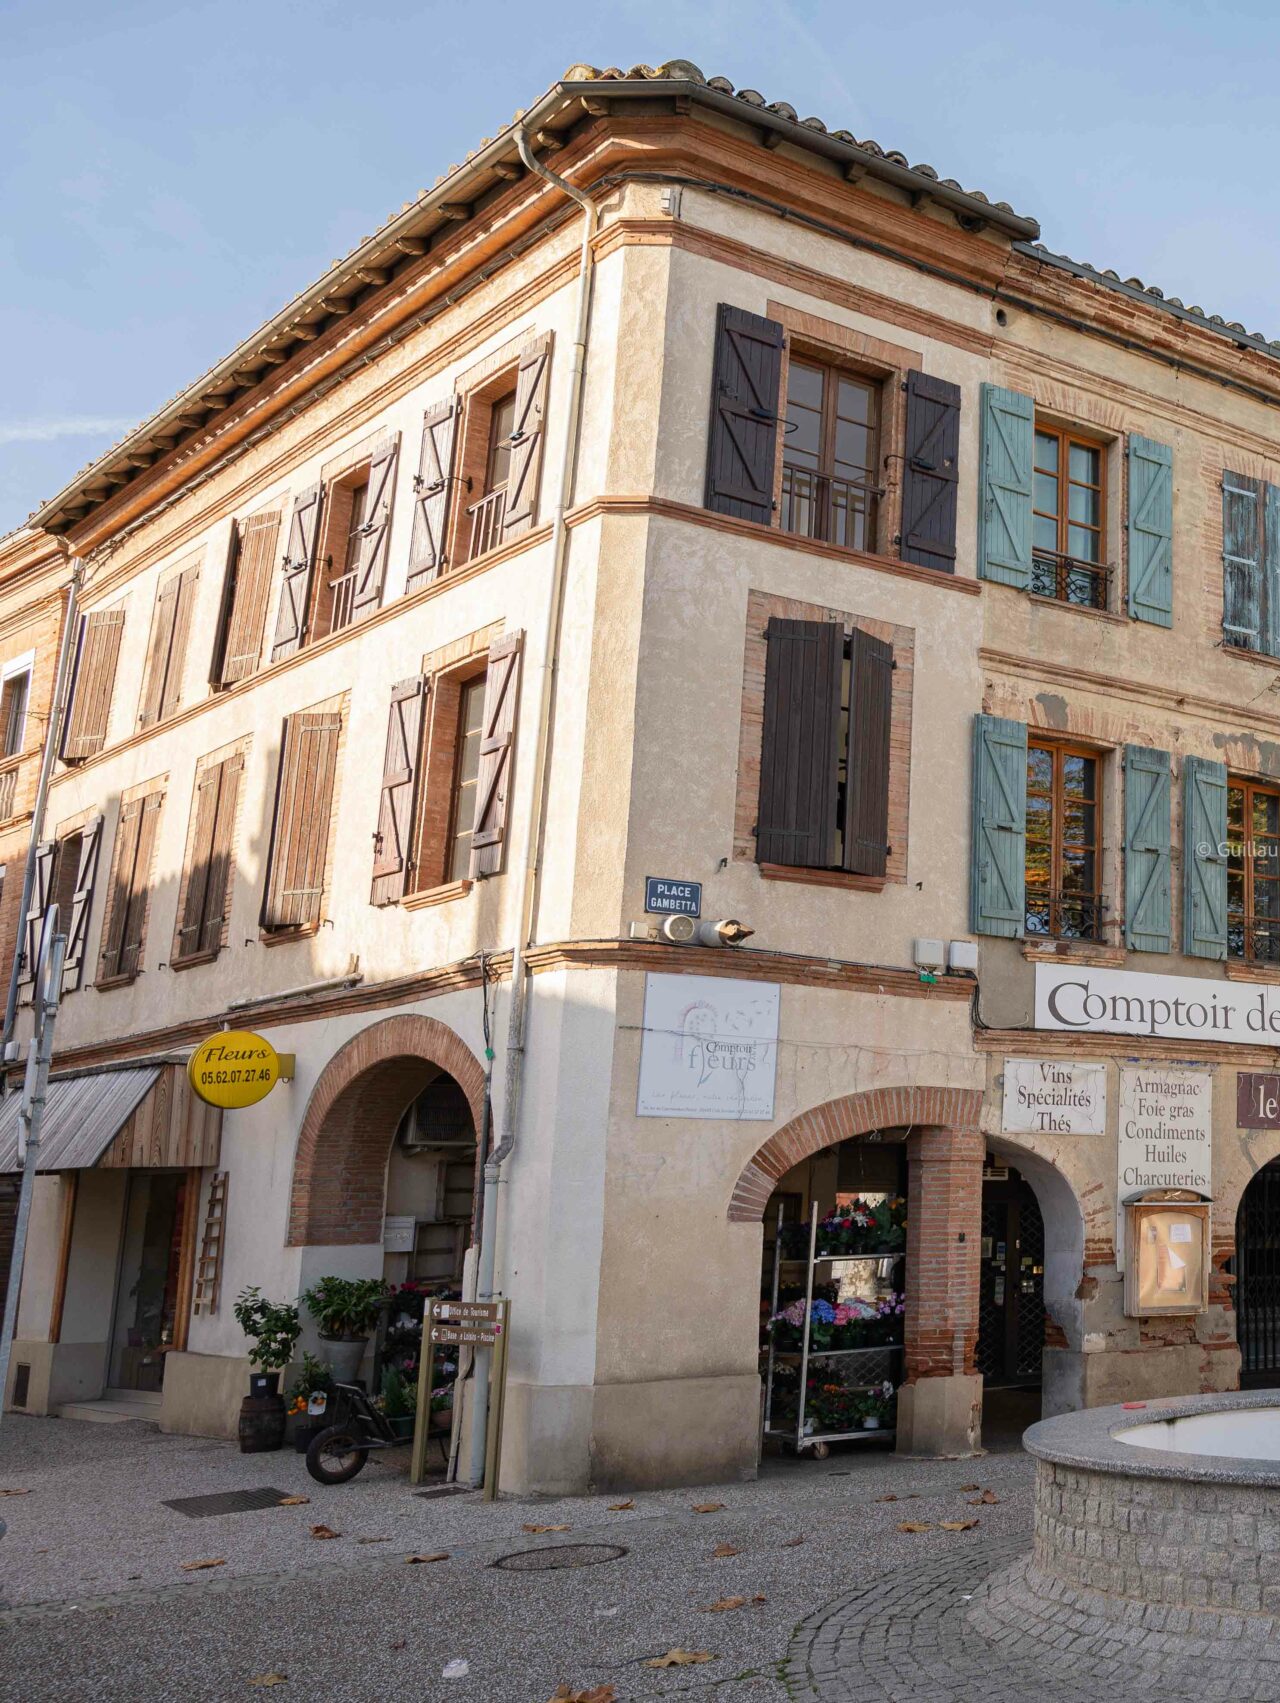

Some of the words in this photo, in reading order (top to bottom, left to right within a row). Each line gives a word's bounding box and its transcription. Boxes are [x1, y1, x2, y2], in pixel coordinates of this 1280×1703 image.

[657, 884, 691, 897] PLACE
[651, 897, 697, 912] GAMBETTA
[1048, 979, 1236, 1035] Comptoir
[202, 1045, 271, 1063] Fleurs
[201, 1068, 271, 1085] 05.62.07.27.46
[1039, 1063, 1073, 1084] Vins
[1017, 1085, 1091, 1109] Spécialités
[1133, 1075, 1200, 1098] Armagnac
[1138, 1098, 1165, 1117] Foie
[1169, 1103, 1194, 1121] gras
[1259, 1085, 1277, 1120] le
[1036, 1111, 1071, 1133] Thés
[1125, 1120, 1206, 1141] Condiments
[1145, 1144, 1187, 1163] Huiles
[1123, 1167, 1206, 1186] Charcuteries
[463, 1307, 468, 1316] de
[470, 1307, 489, 1317] Tourisme
